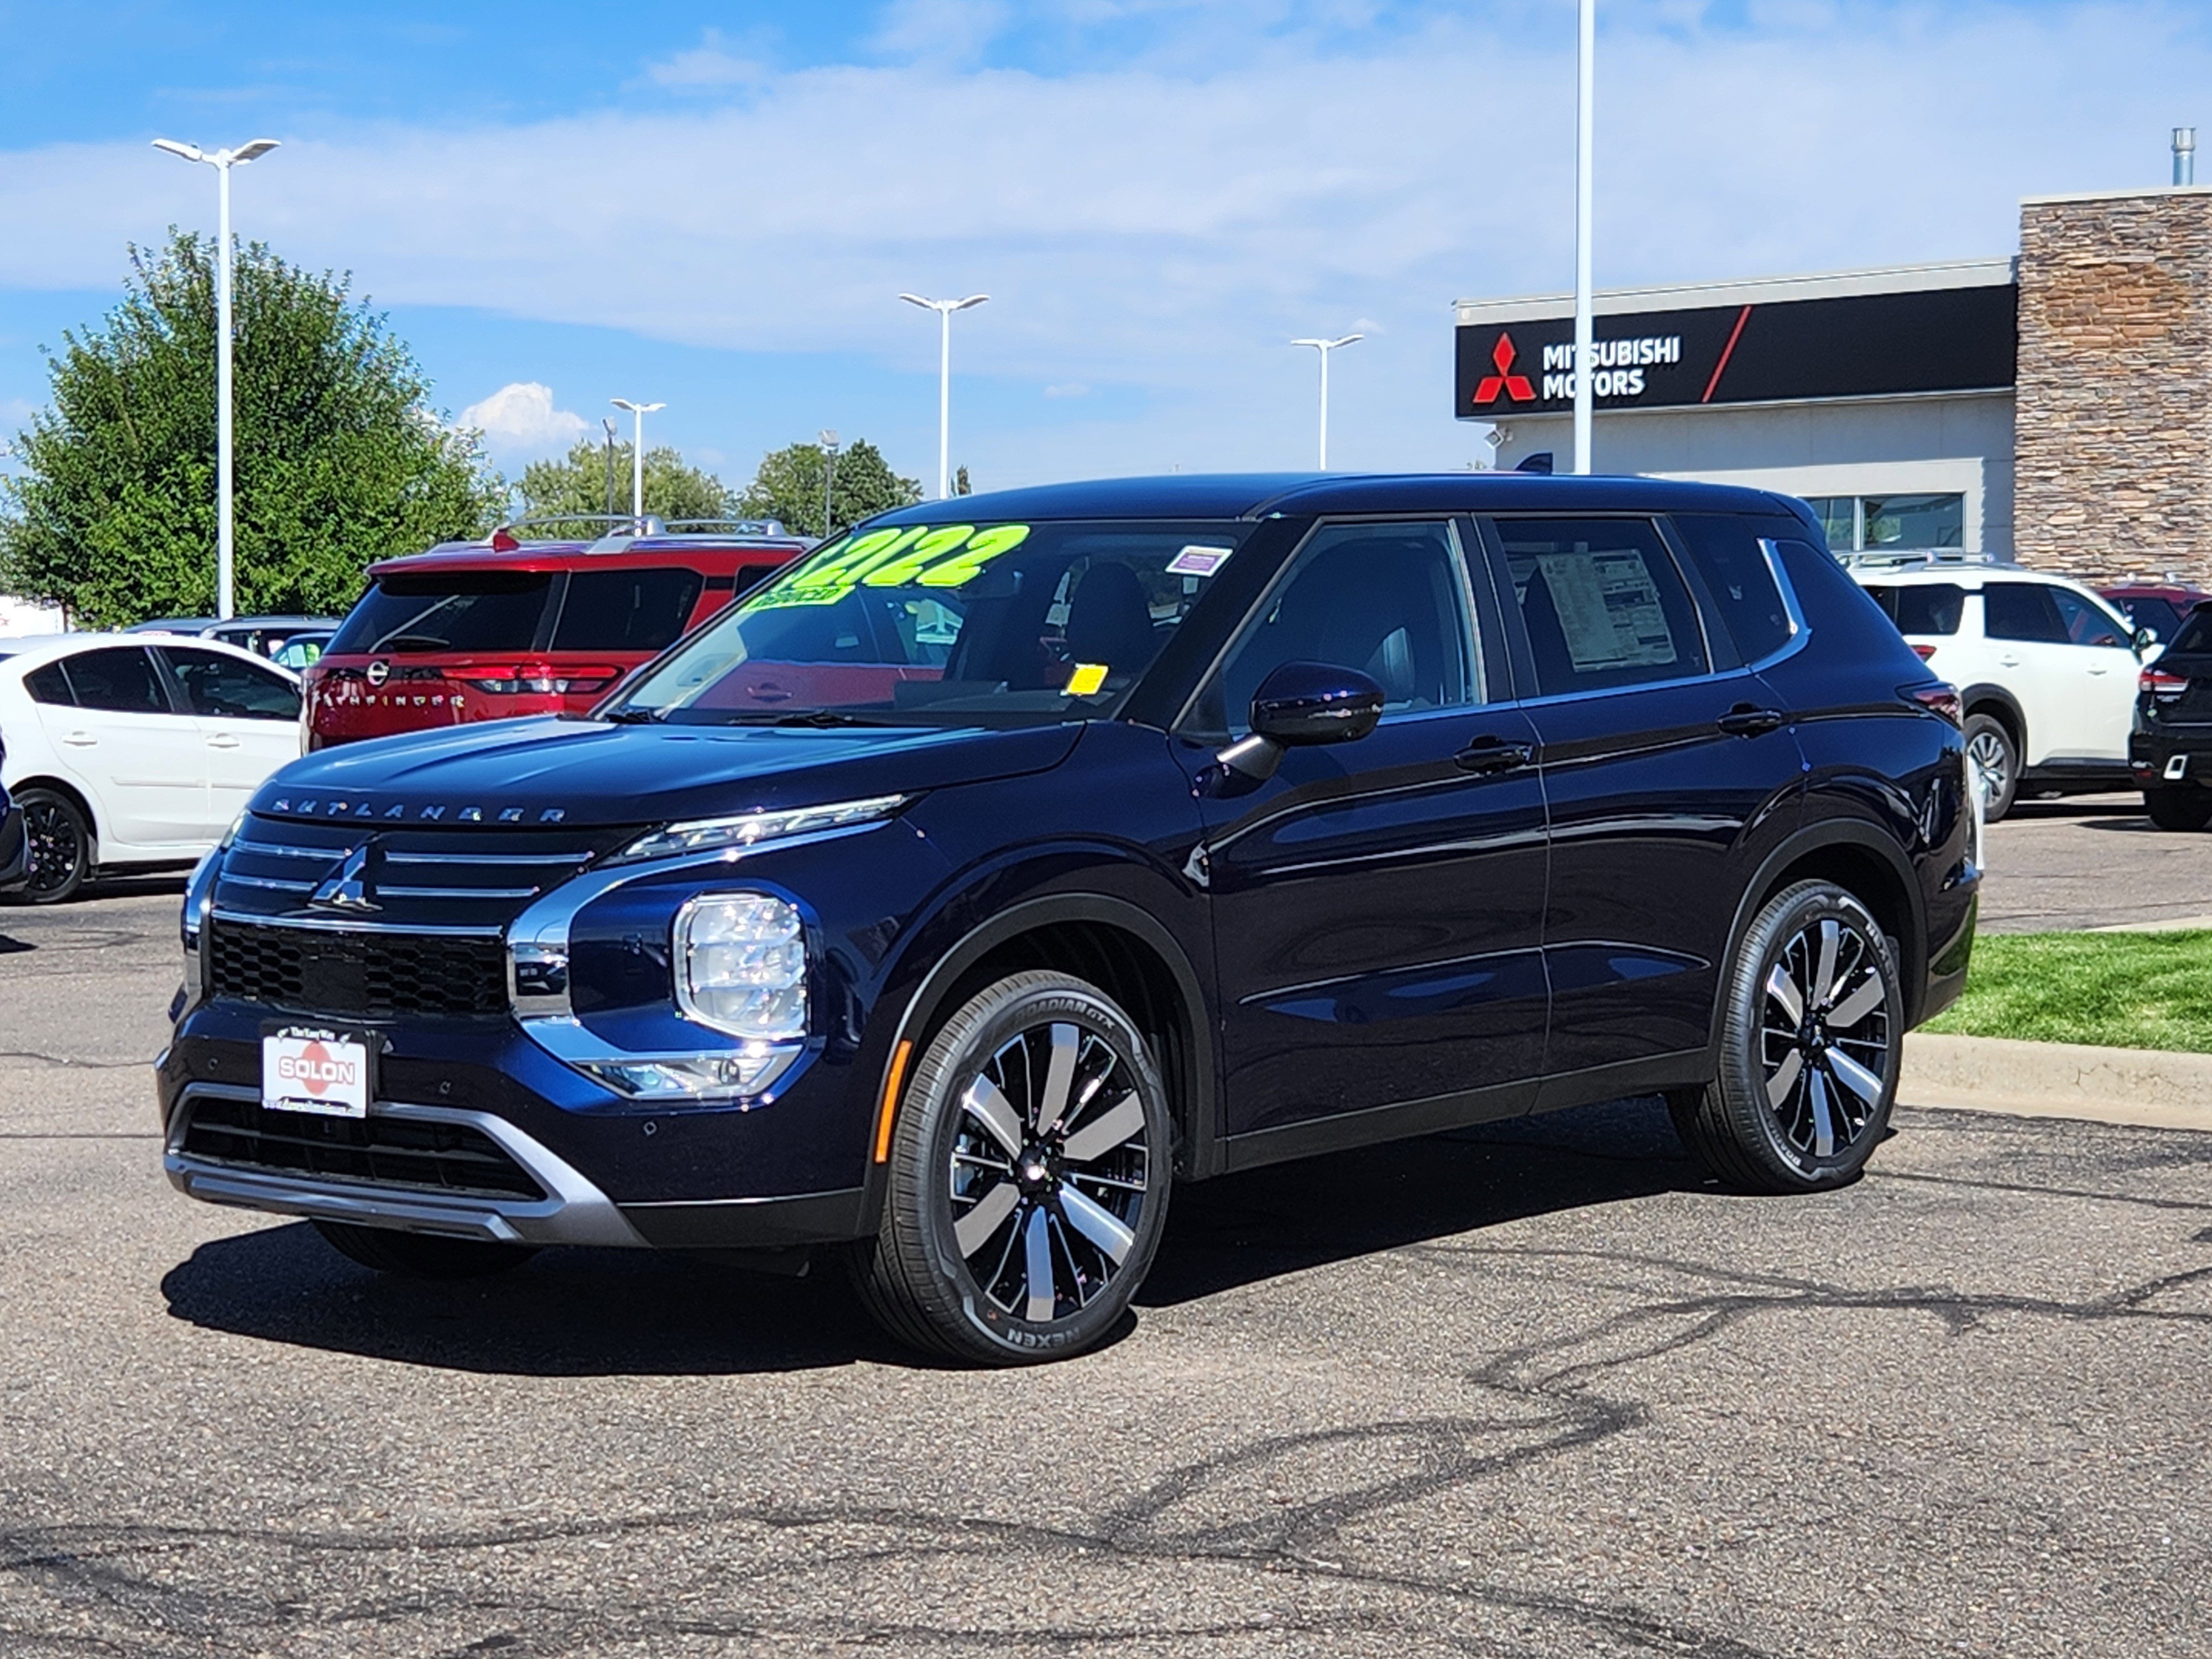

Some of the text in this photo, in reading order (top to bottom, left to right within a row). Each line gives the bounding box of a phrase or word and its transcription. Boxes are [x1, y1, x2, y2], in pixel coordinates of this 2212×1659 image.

[273, 799, 565, 823] OUTLANDER
[279, 1055, 355, 1086] SOLON
[1007, 1327, 1081, 1348] NEXEN
